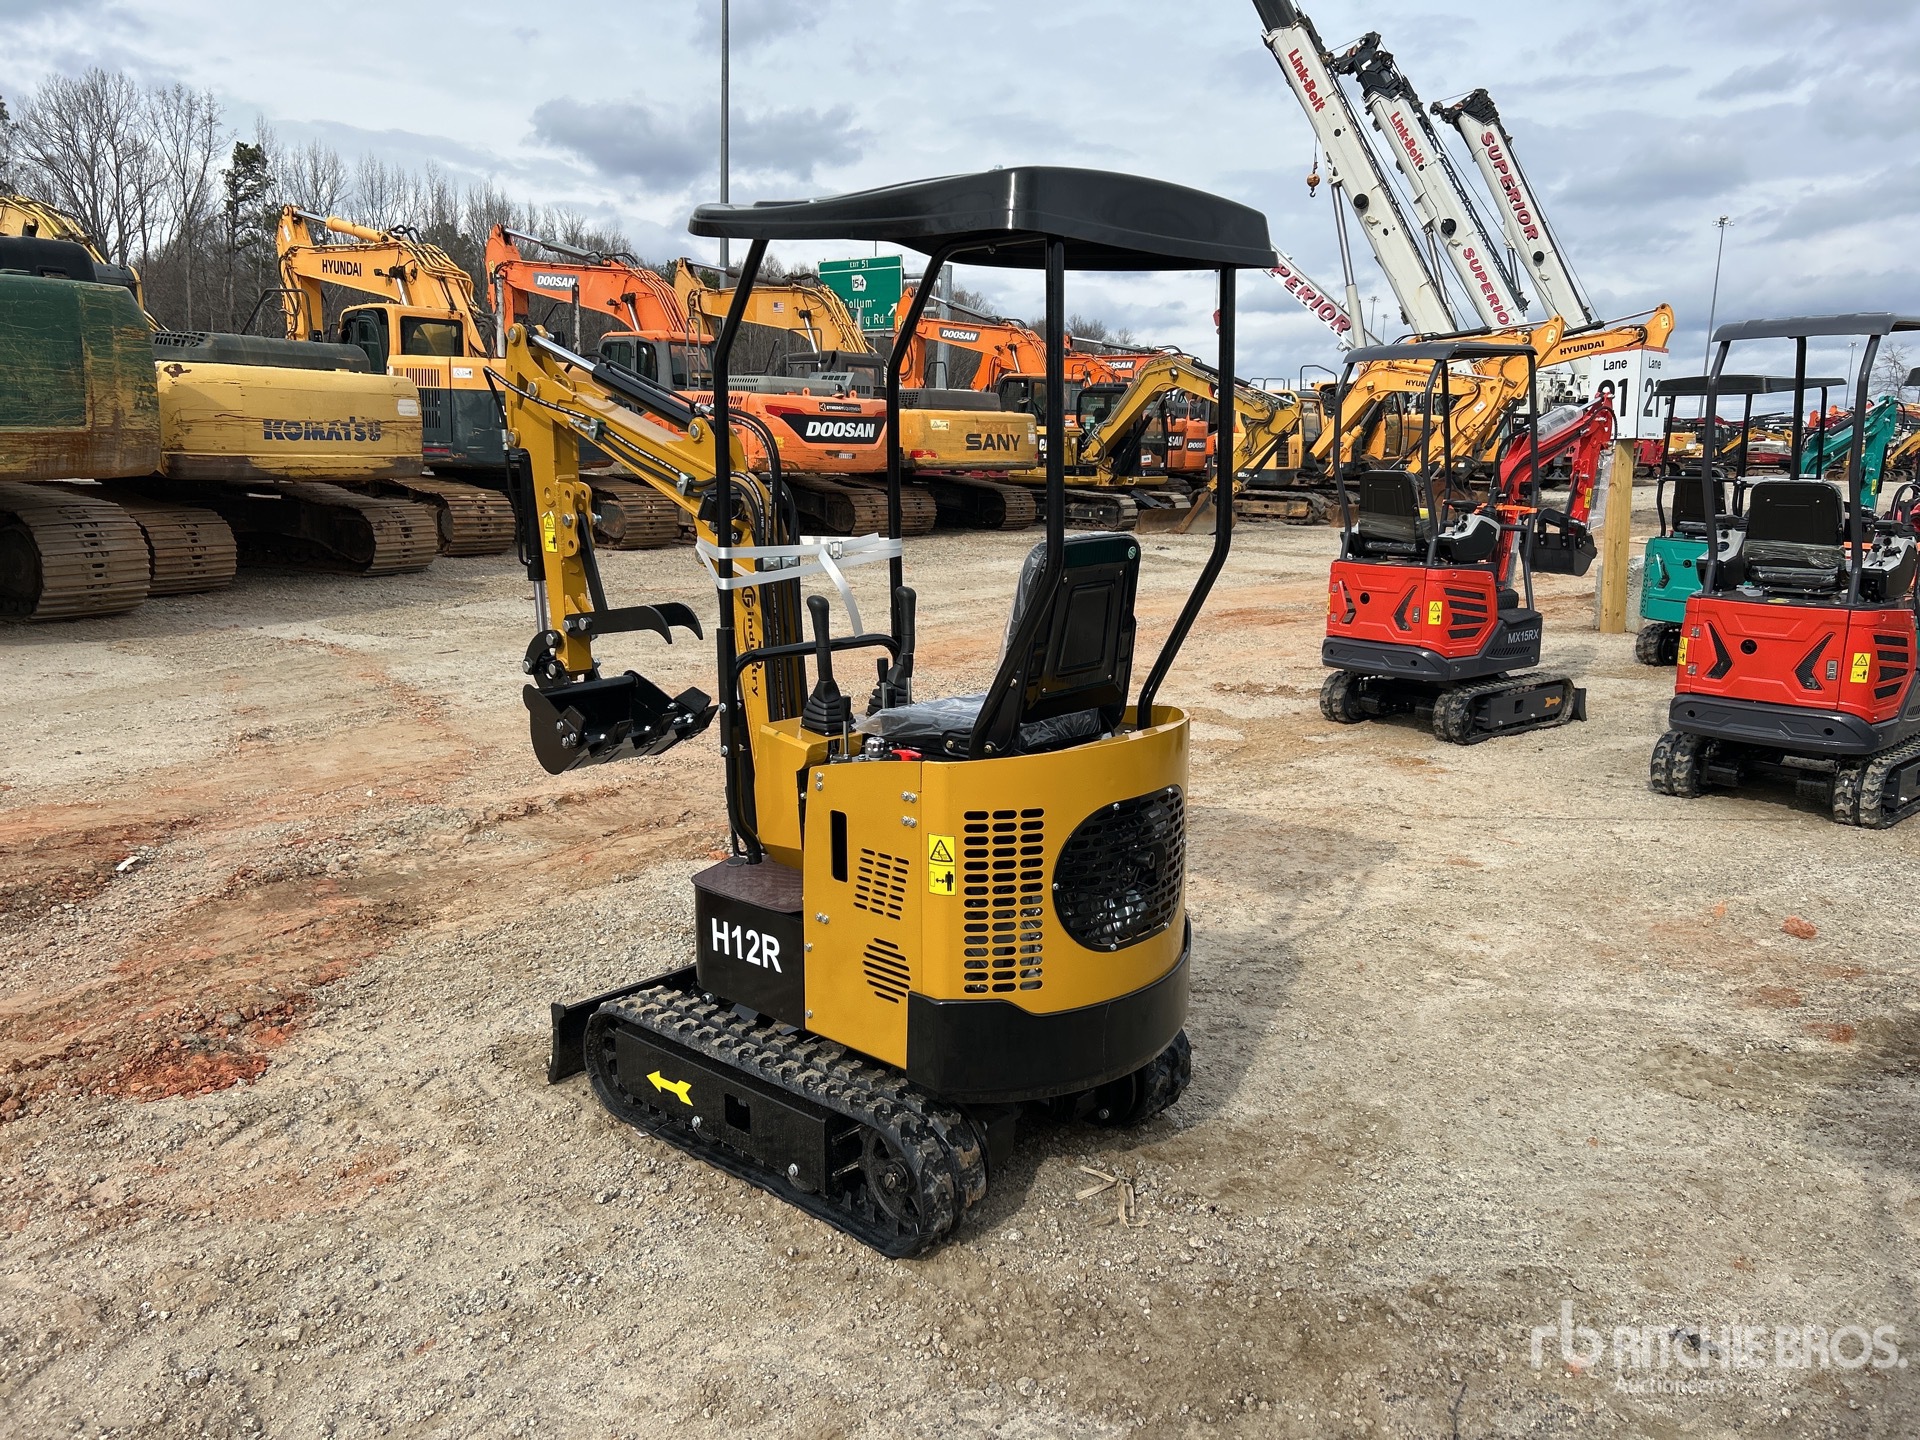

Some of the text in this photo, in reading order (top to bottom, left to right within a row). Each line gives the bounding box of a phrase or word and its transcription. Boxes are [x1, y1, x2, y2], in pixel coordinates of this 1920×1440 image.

[1288, 48, 1325, 113] Link-Belt
[1391, 111, 1424, 167] Link-Belt
[1481, 132, 1538, 241] SUPERIOR
[322, 259, 362, 277] HYUNDAI
[861, 260, 869, 268] 51
[537, 275, 576, 287] DOOSAN
[853, 279, 864, 288] 154
[1463, 247, 1509, 325] SUPERIO
[1271, 263, 1351, 336] PERIOR
[874, 314, 884, 324] Rd
[942, 329, 977, 341] DOOSAN
[1560, 340, 1605, 355] HYUNDAI
[1603, 359, 1628, 371] Lane
[1648, 357, 1661, 369] Lane
[1405, 379, 1440, 389] HYUNAI
[262, 416, 381, 442] KOMATSU
[805, 421, 876, 438] DOOSAN
[965, 433, 1021, 451] SANY
[1168, 435, 1184, 447] SAN
[1507, 629, 1539, 644] MX15RX
[711, 917, 782, 973] H12R
